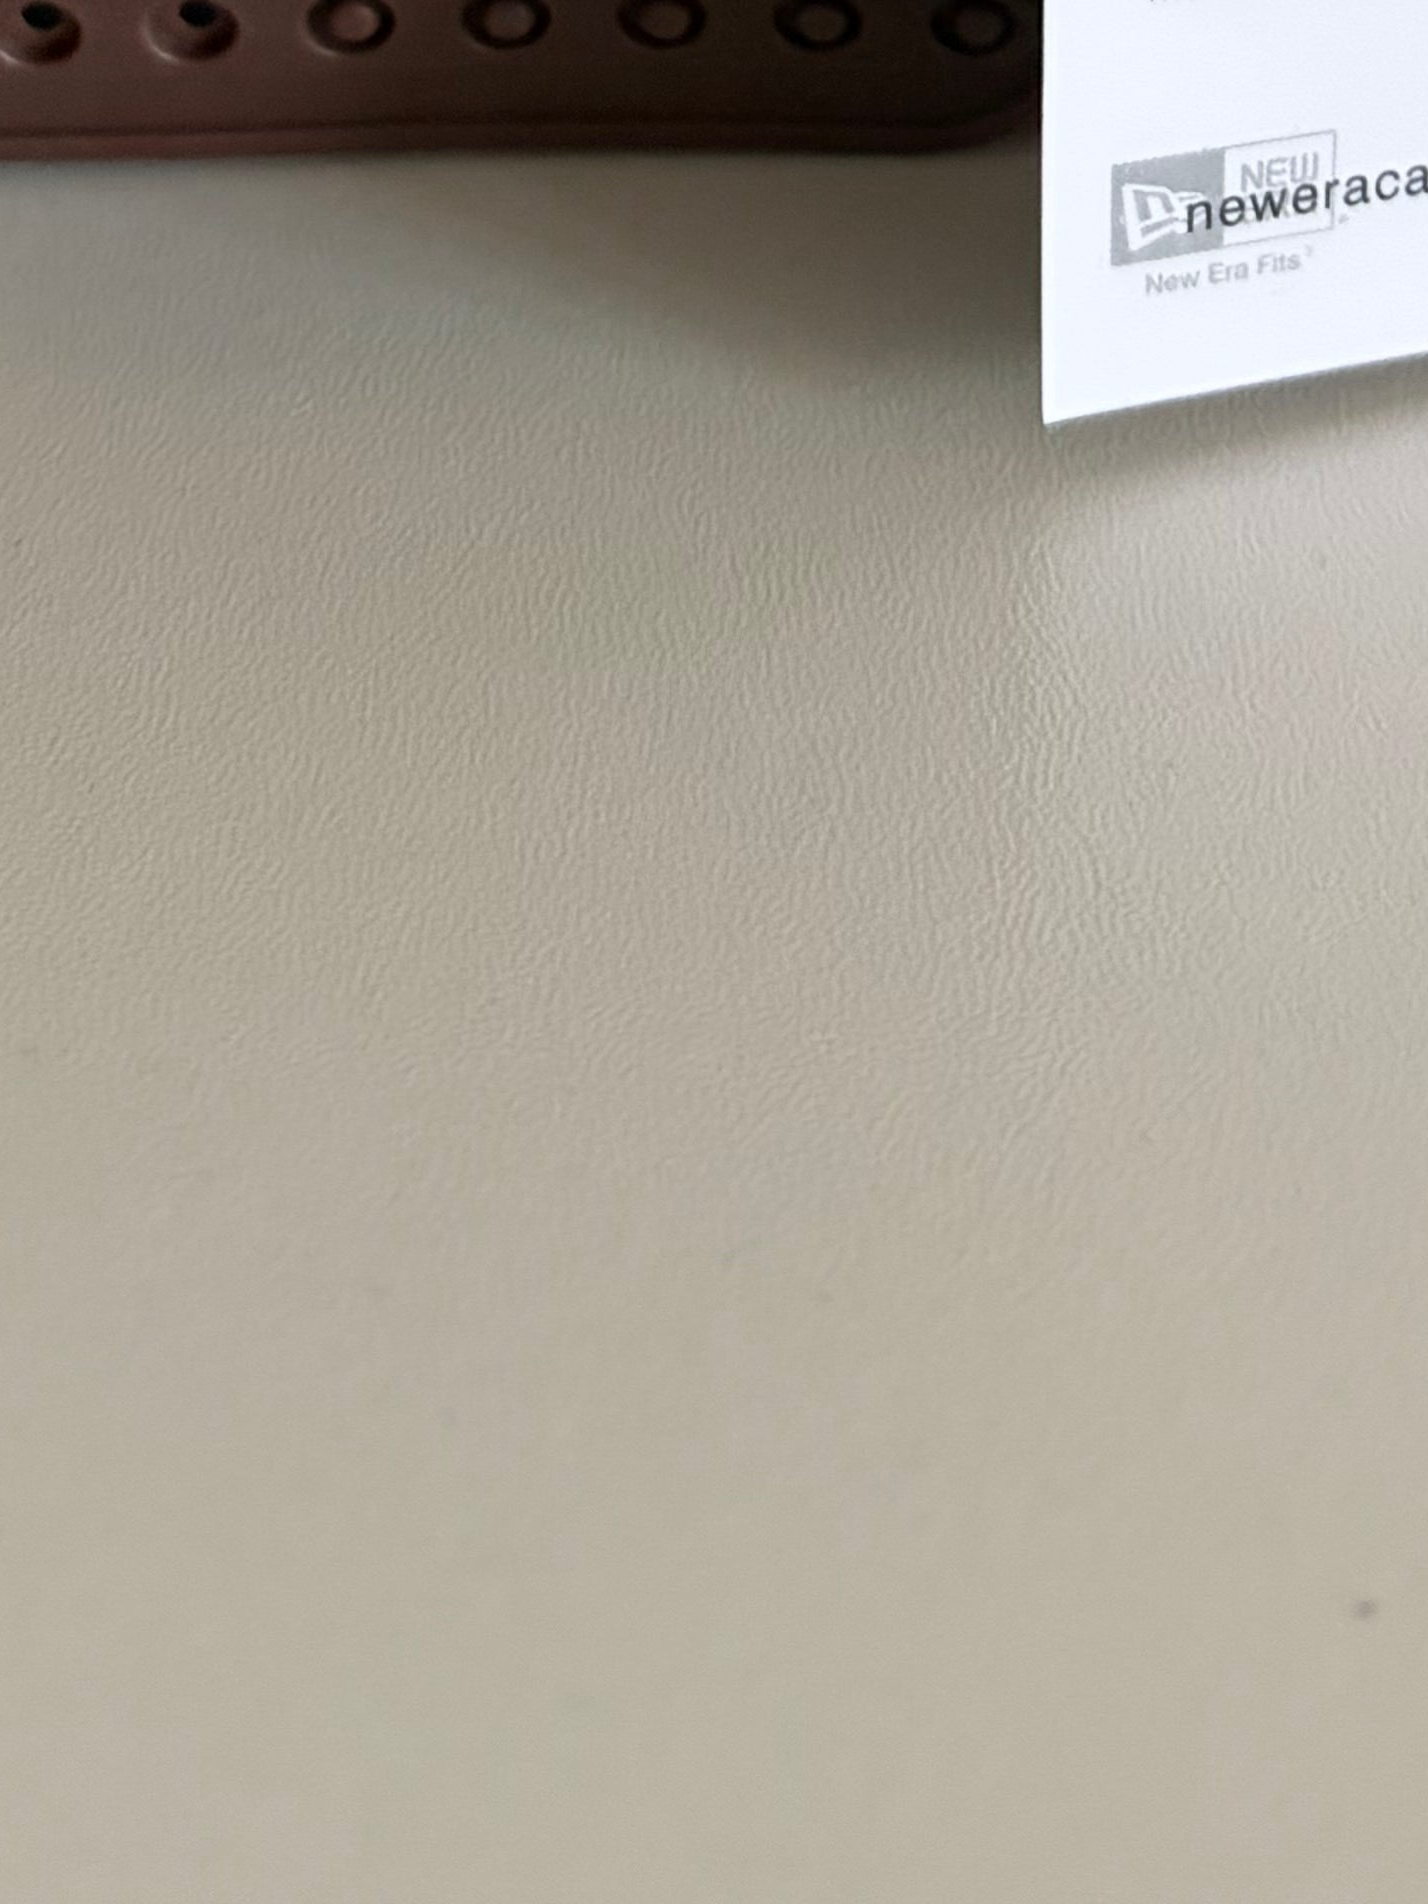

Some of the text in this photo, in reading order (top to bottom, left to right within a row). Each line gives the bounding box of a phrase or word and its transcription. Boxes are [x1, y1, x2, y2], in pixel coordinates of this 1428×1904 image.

[1241, 151, 1319, 193] NEW
[1145, 270, 1201, 296] New
[1208, 262, 1250, 285] Era
